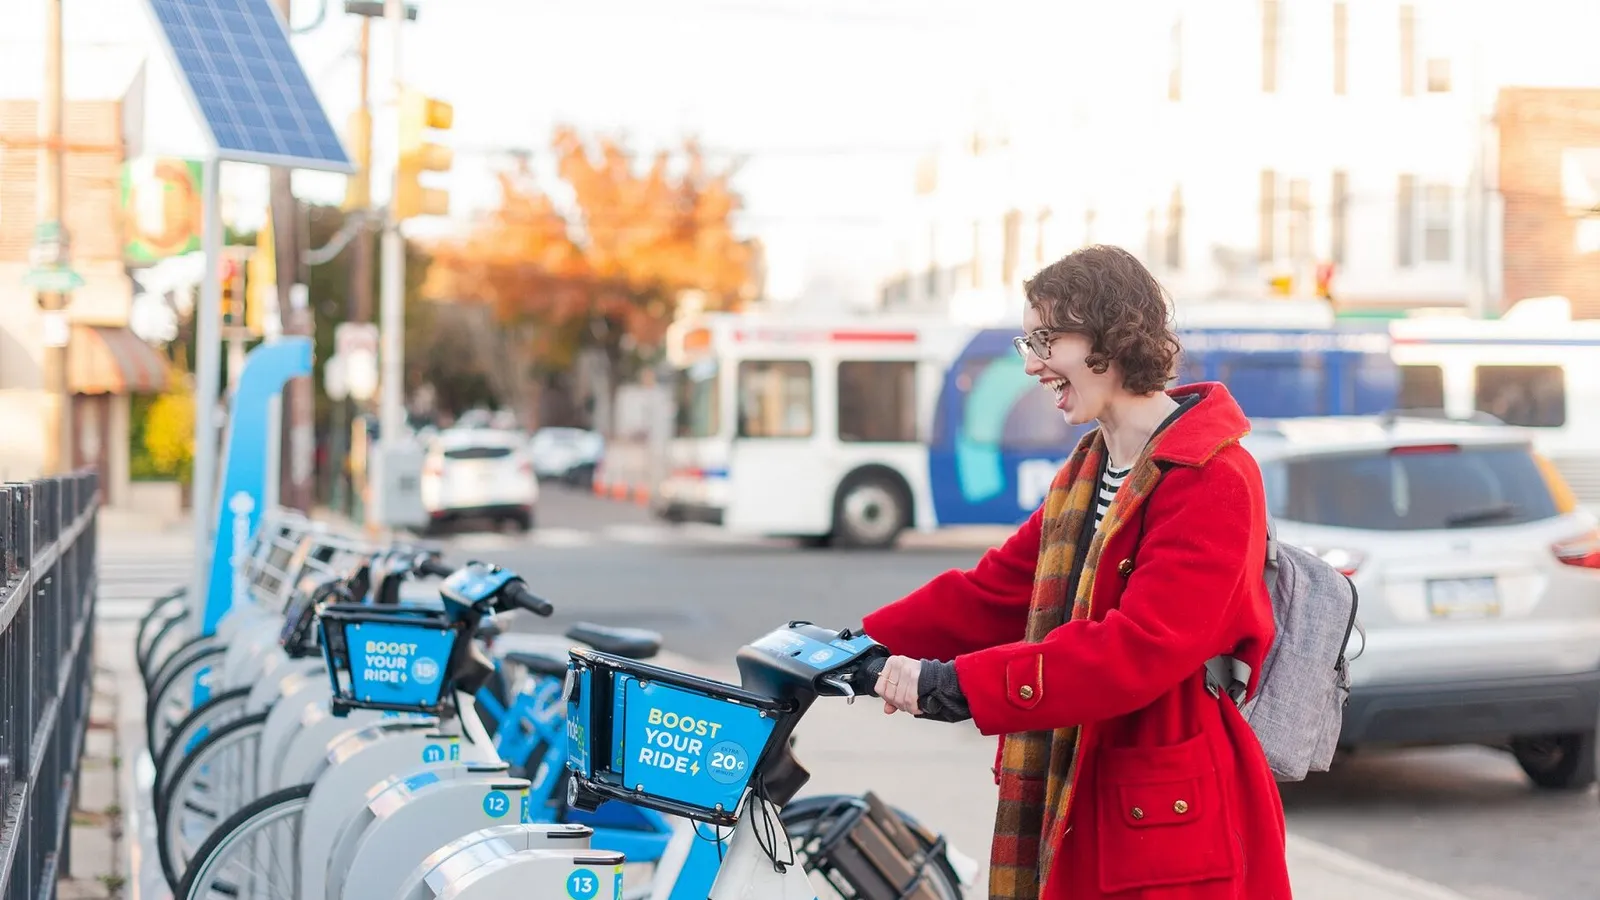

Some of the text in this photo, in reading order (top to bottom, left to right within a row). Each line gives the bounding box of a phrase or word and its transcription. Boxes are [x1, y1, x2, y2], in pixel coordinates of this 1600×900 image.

[365, 640, 418, 656] BOOST
[365, 655, 407, 669] YOUR
[364, 669, 398, 683] RIDE
[648, 708, 722, 739] BOOST
[645, 727, 703, 756] YOUR
[428, 748, 440, 762] 11
[720, 746, 739, 755] EXTRA
[638, 748, 687, 773] RIDE
[711, 751, 745, 771] 20¢
[488, 797, 505, 811] 12
[572, 876, 592, 893] 13
